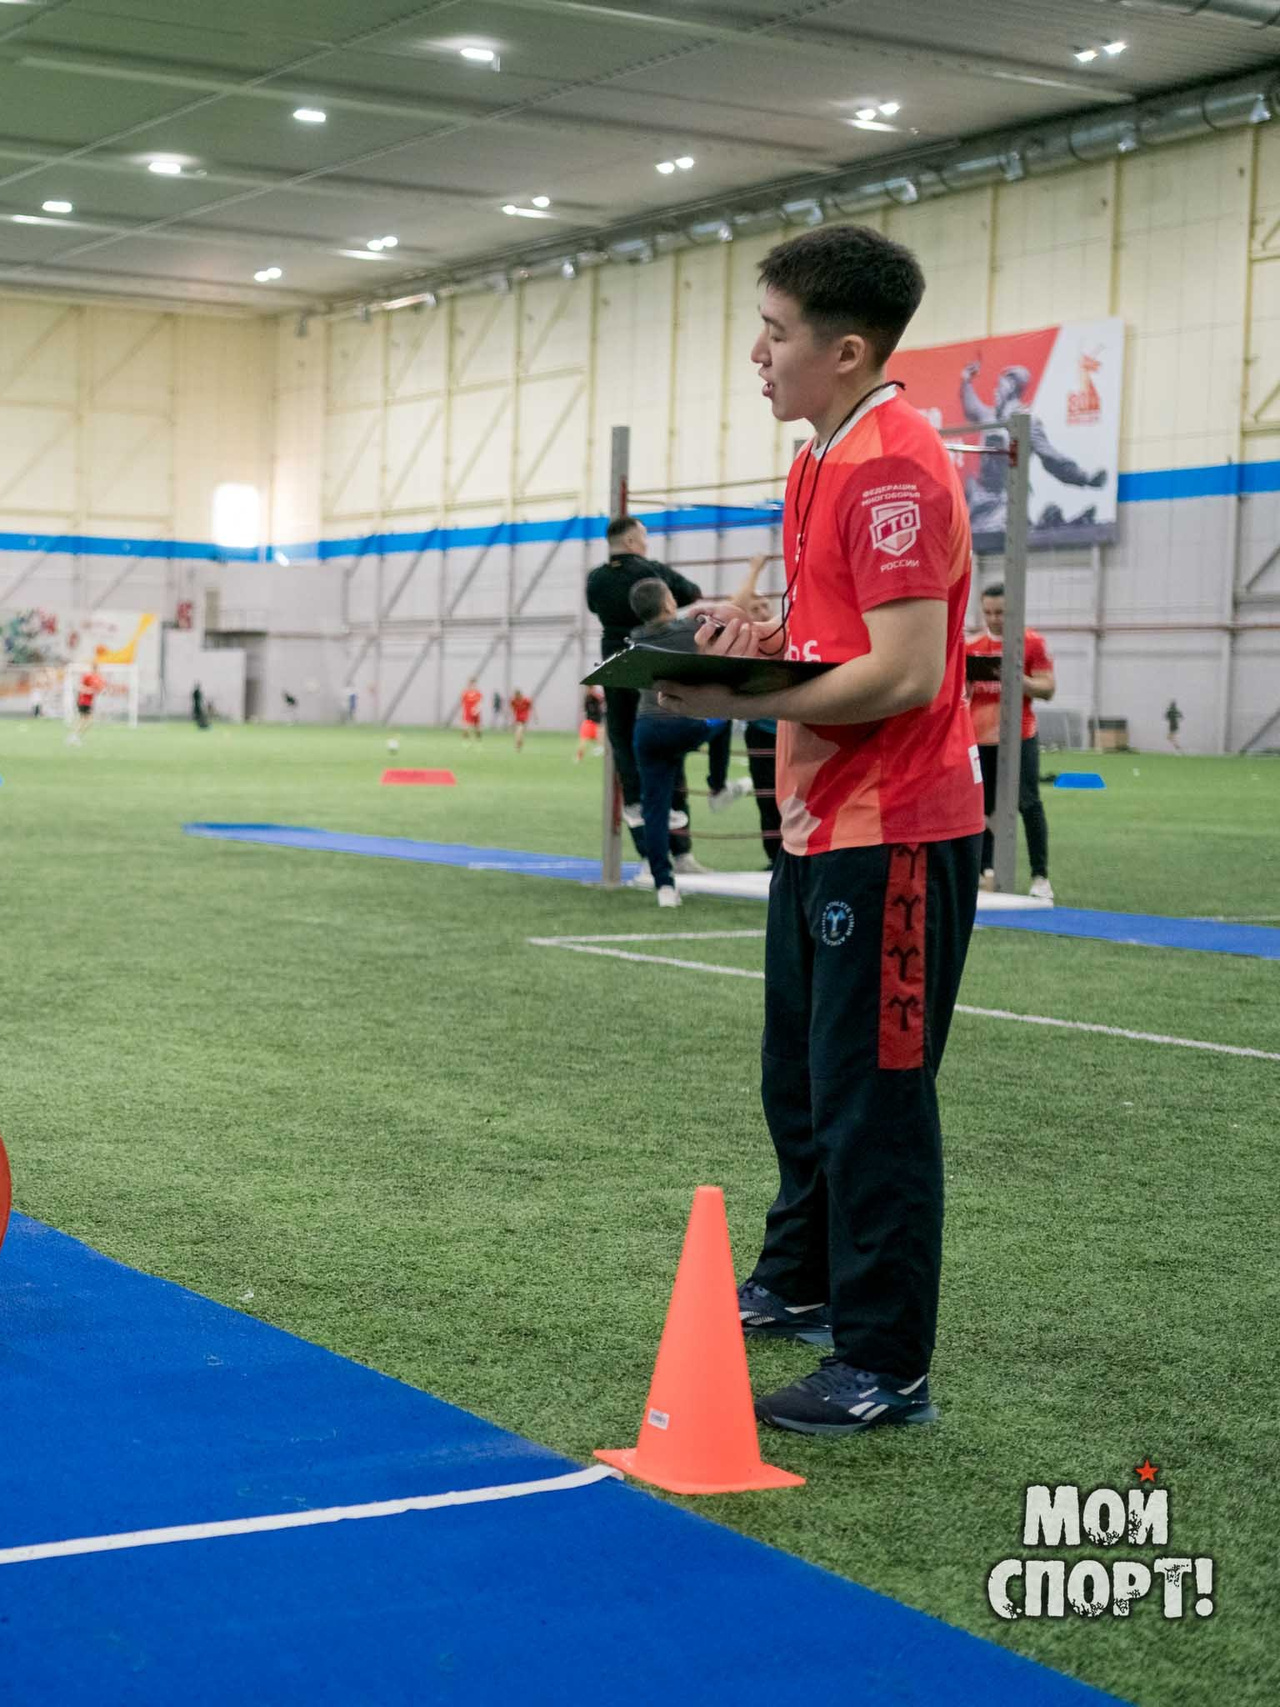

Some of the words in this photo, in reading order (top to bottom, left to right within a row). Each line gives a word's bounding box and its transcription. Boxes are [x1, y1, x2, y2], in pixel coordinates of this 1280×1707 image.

[862, 484, 918, 498] ФЕДЕРАЦИЯ
[876, 512, 914, 541] ГТО
[880, 559, 919, 573] РОССИИ
